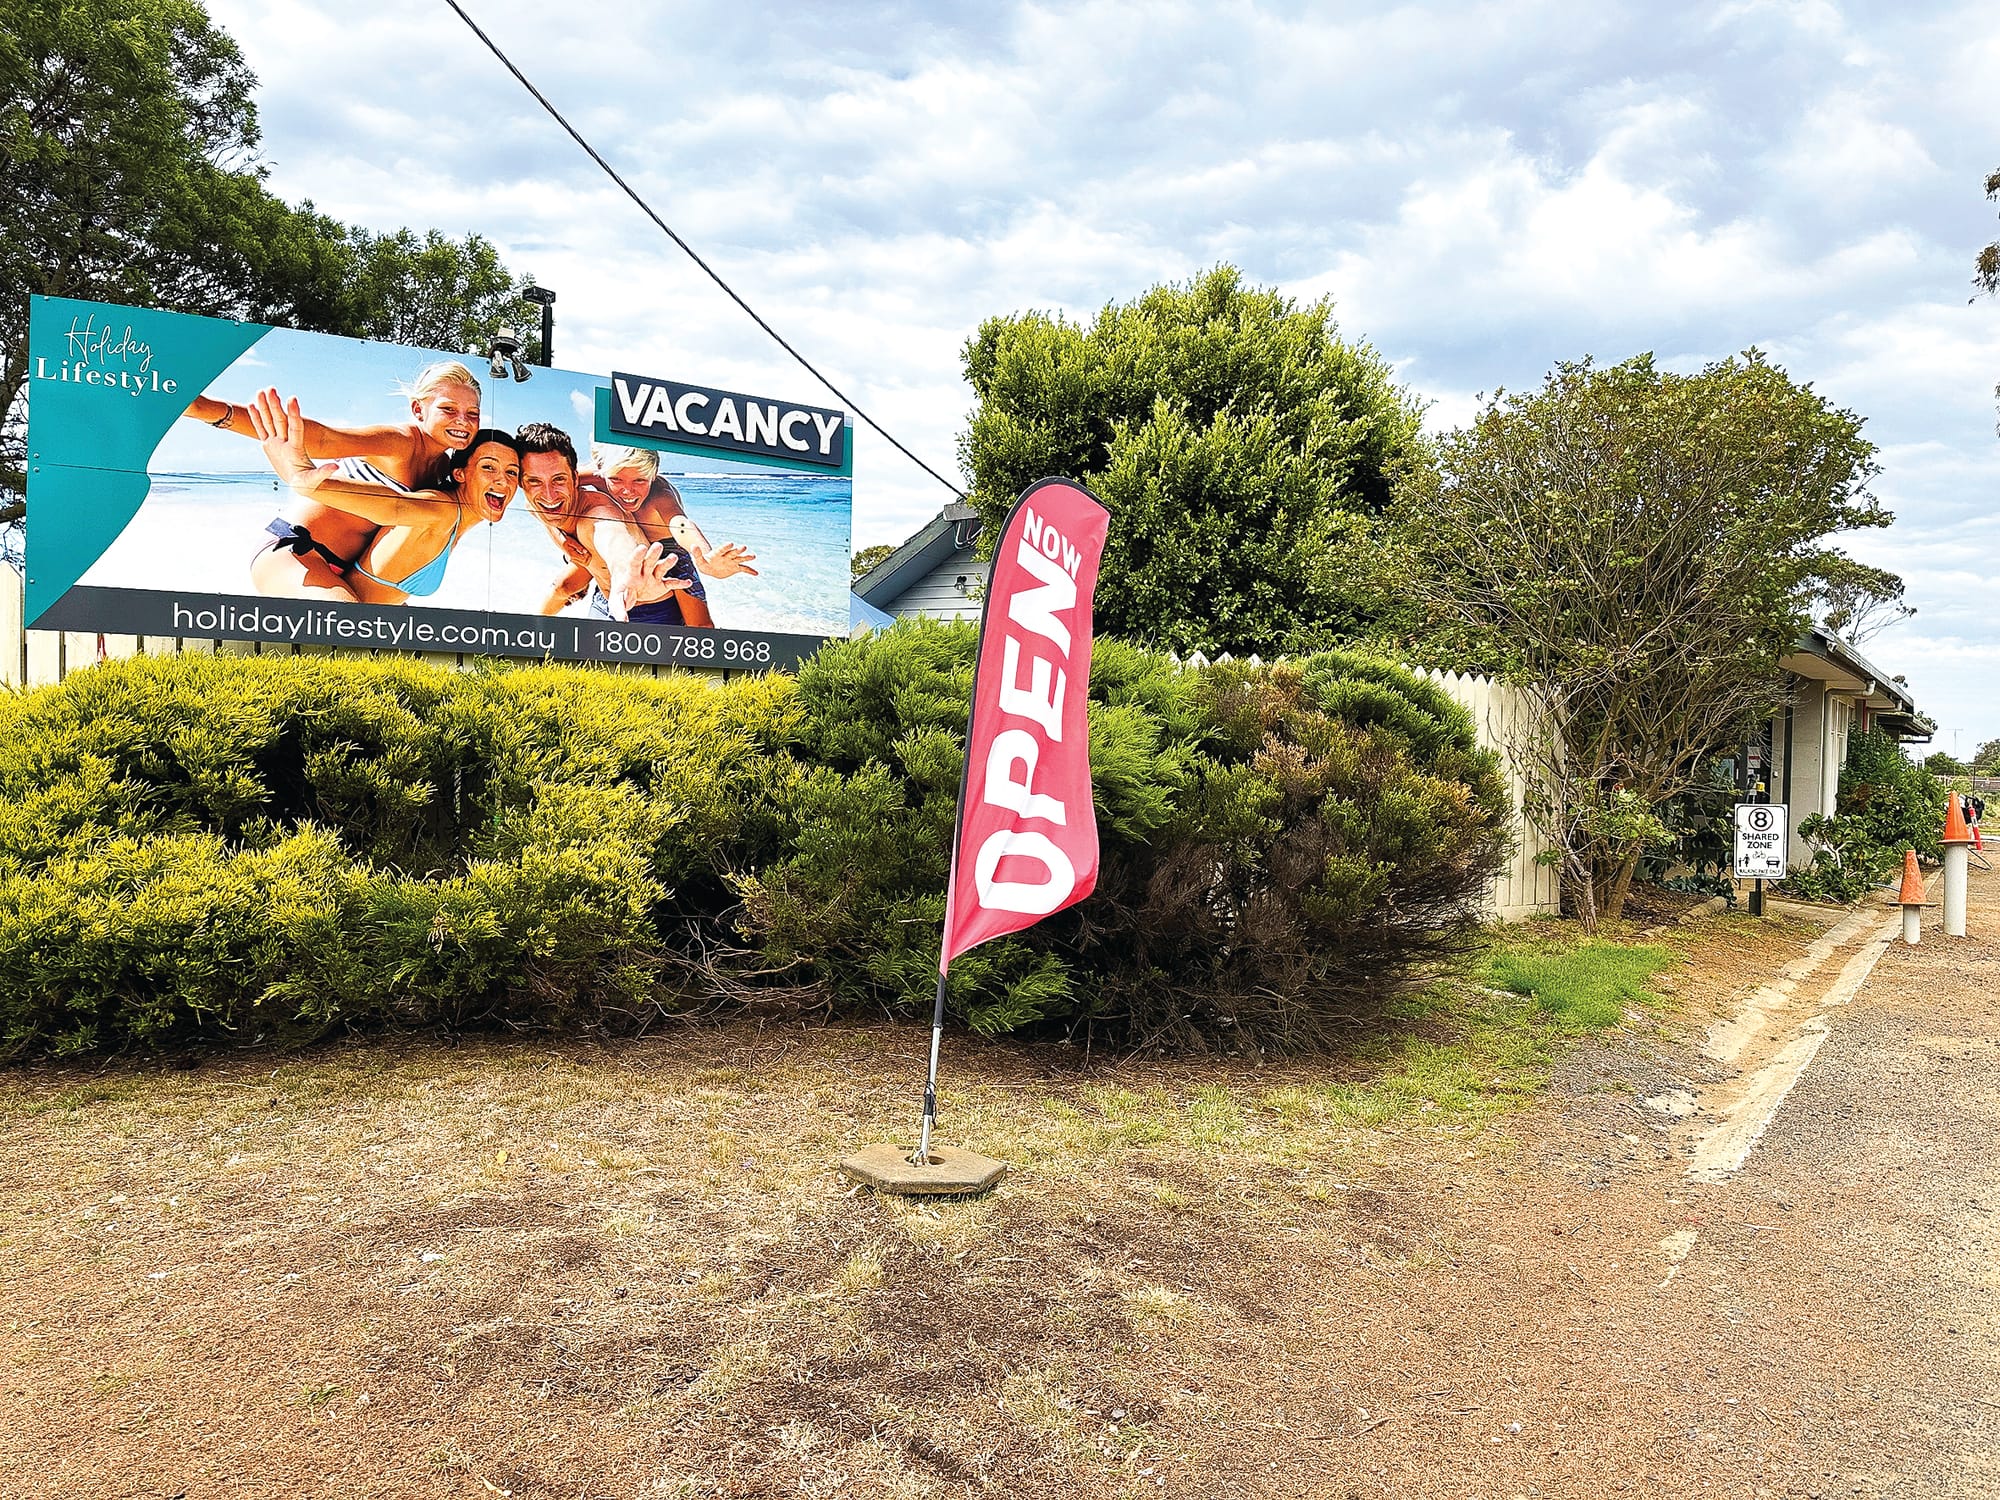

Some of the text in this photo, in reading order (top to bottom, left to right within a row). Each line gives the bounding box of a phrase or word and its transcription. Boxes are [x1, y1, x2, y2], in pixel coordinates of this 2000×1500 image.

[64, 313, 154, 372] Holiday
[35, 357, 178, 397] Lifestyle
[614, 379, 842, 455] VACANCY
[1022, 506, 1082, 581] NOW
[173, 602, 556, 650] holidaylifestyle.com.au
[594, 631, 662, 656] 1800
[669, 635, 715, 660] 788
[723, 639, 771, 663] 968
[974, 537, 1078, 915] OPEN
[1742, 832, 1779, 841] SHARED
[1747, 841, 1773, 849] ZONE
[1754, 811, 1768, 828] 8
